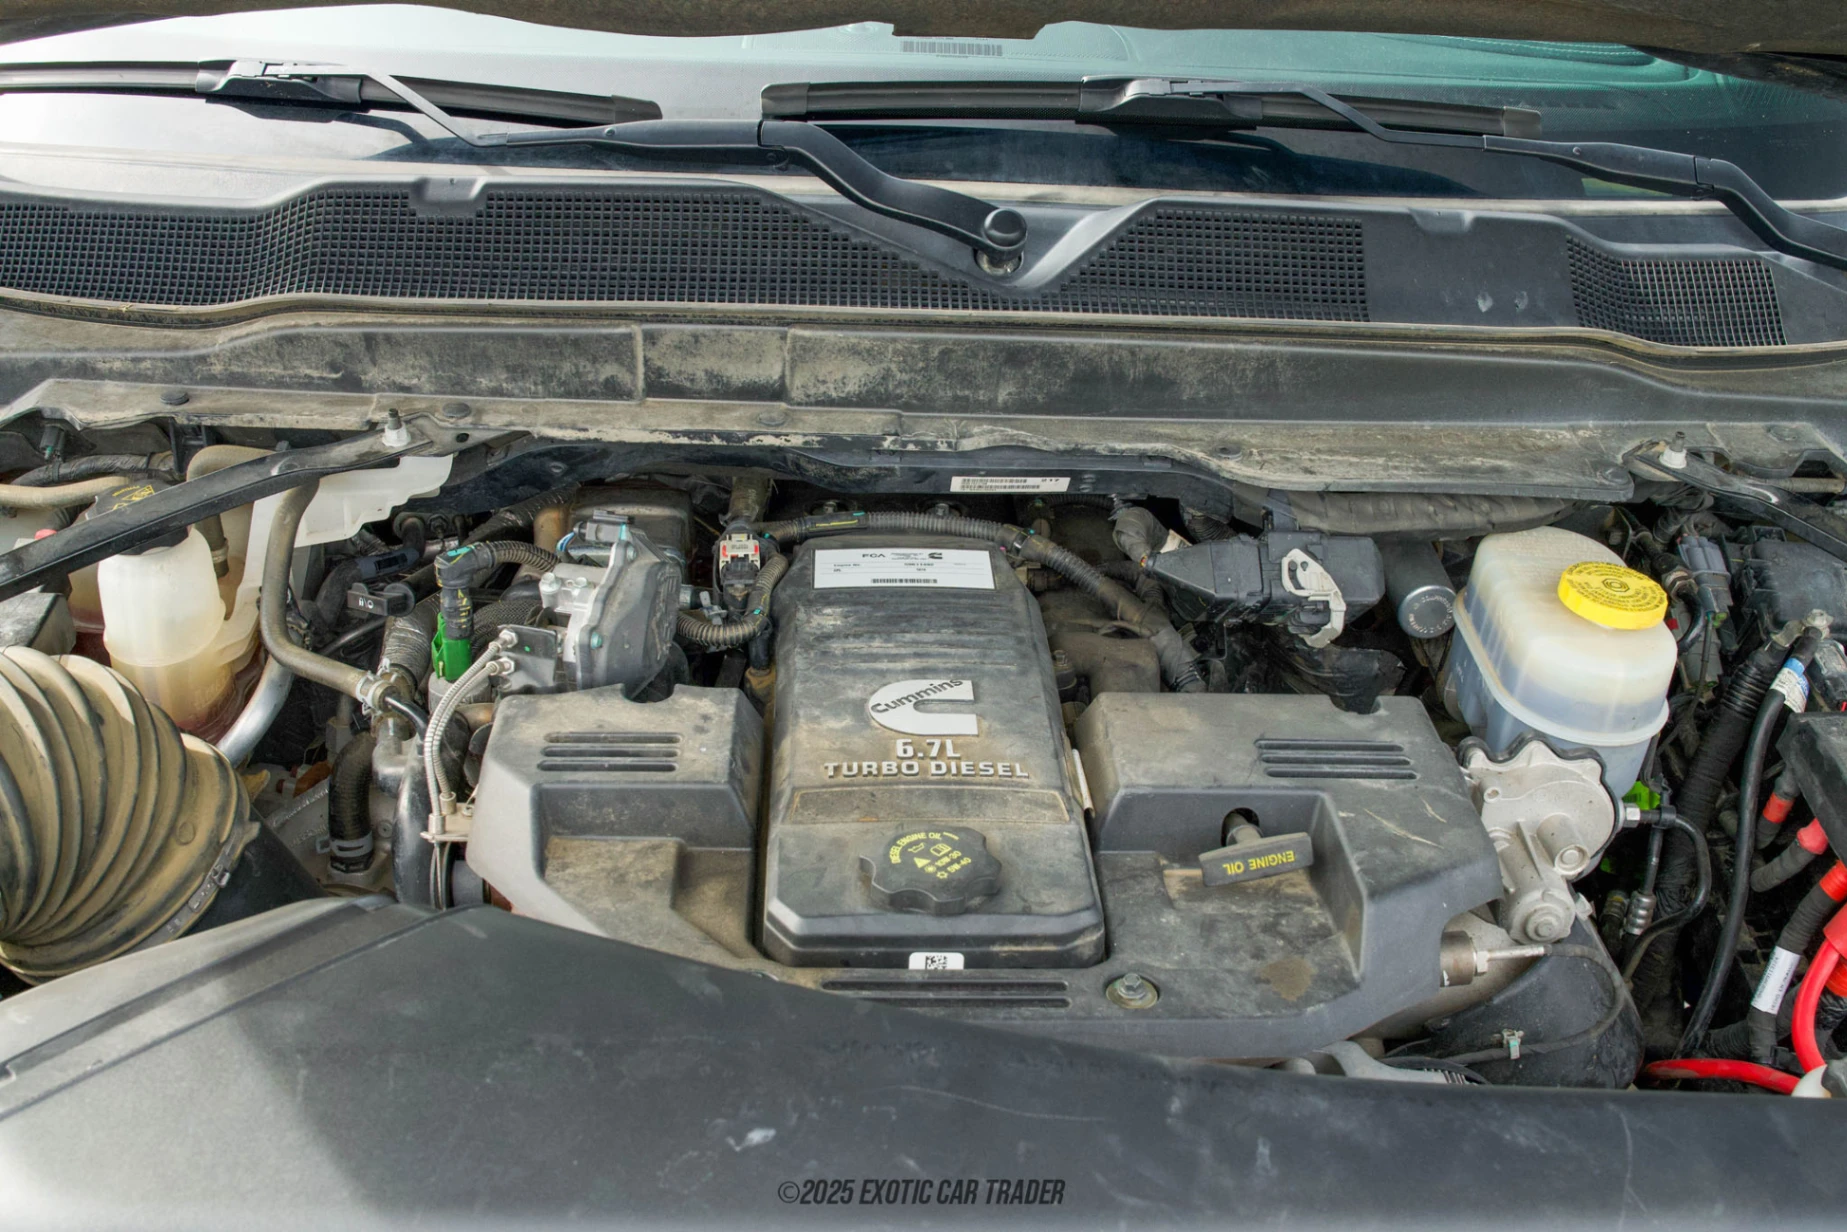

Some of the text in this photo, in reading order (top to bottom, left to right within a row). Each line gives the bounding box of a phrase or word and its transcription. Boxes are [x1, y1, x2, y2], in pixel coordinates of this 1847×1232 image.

[870, 678, 964, 714] Cummins
[896, 738, 961, 760] 6.7L
[825, 760, 1030, 779] TURBO DIESEL
[889, 832, 943, 864] DIESEL ENGINE OIL
[1222, 850, 1296, 875] ENGINE OIL
